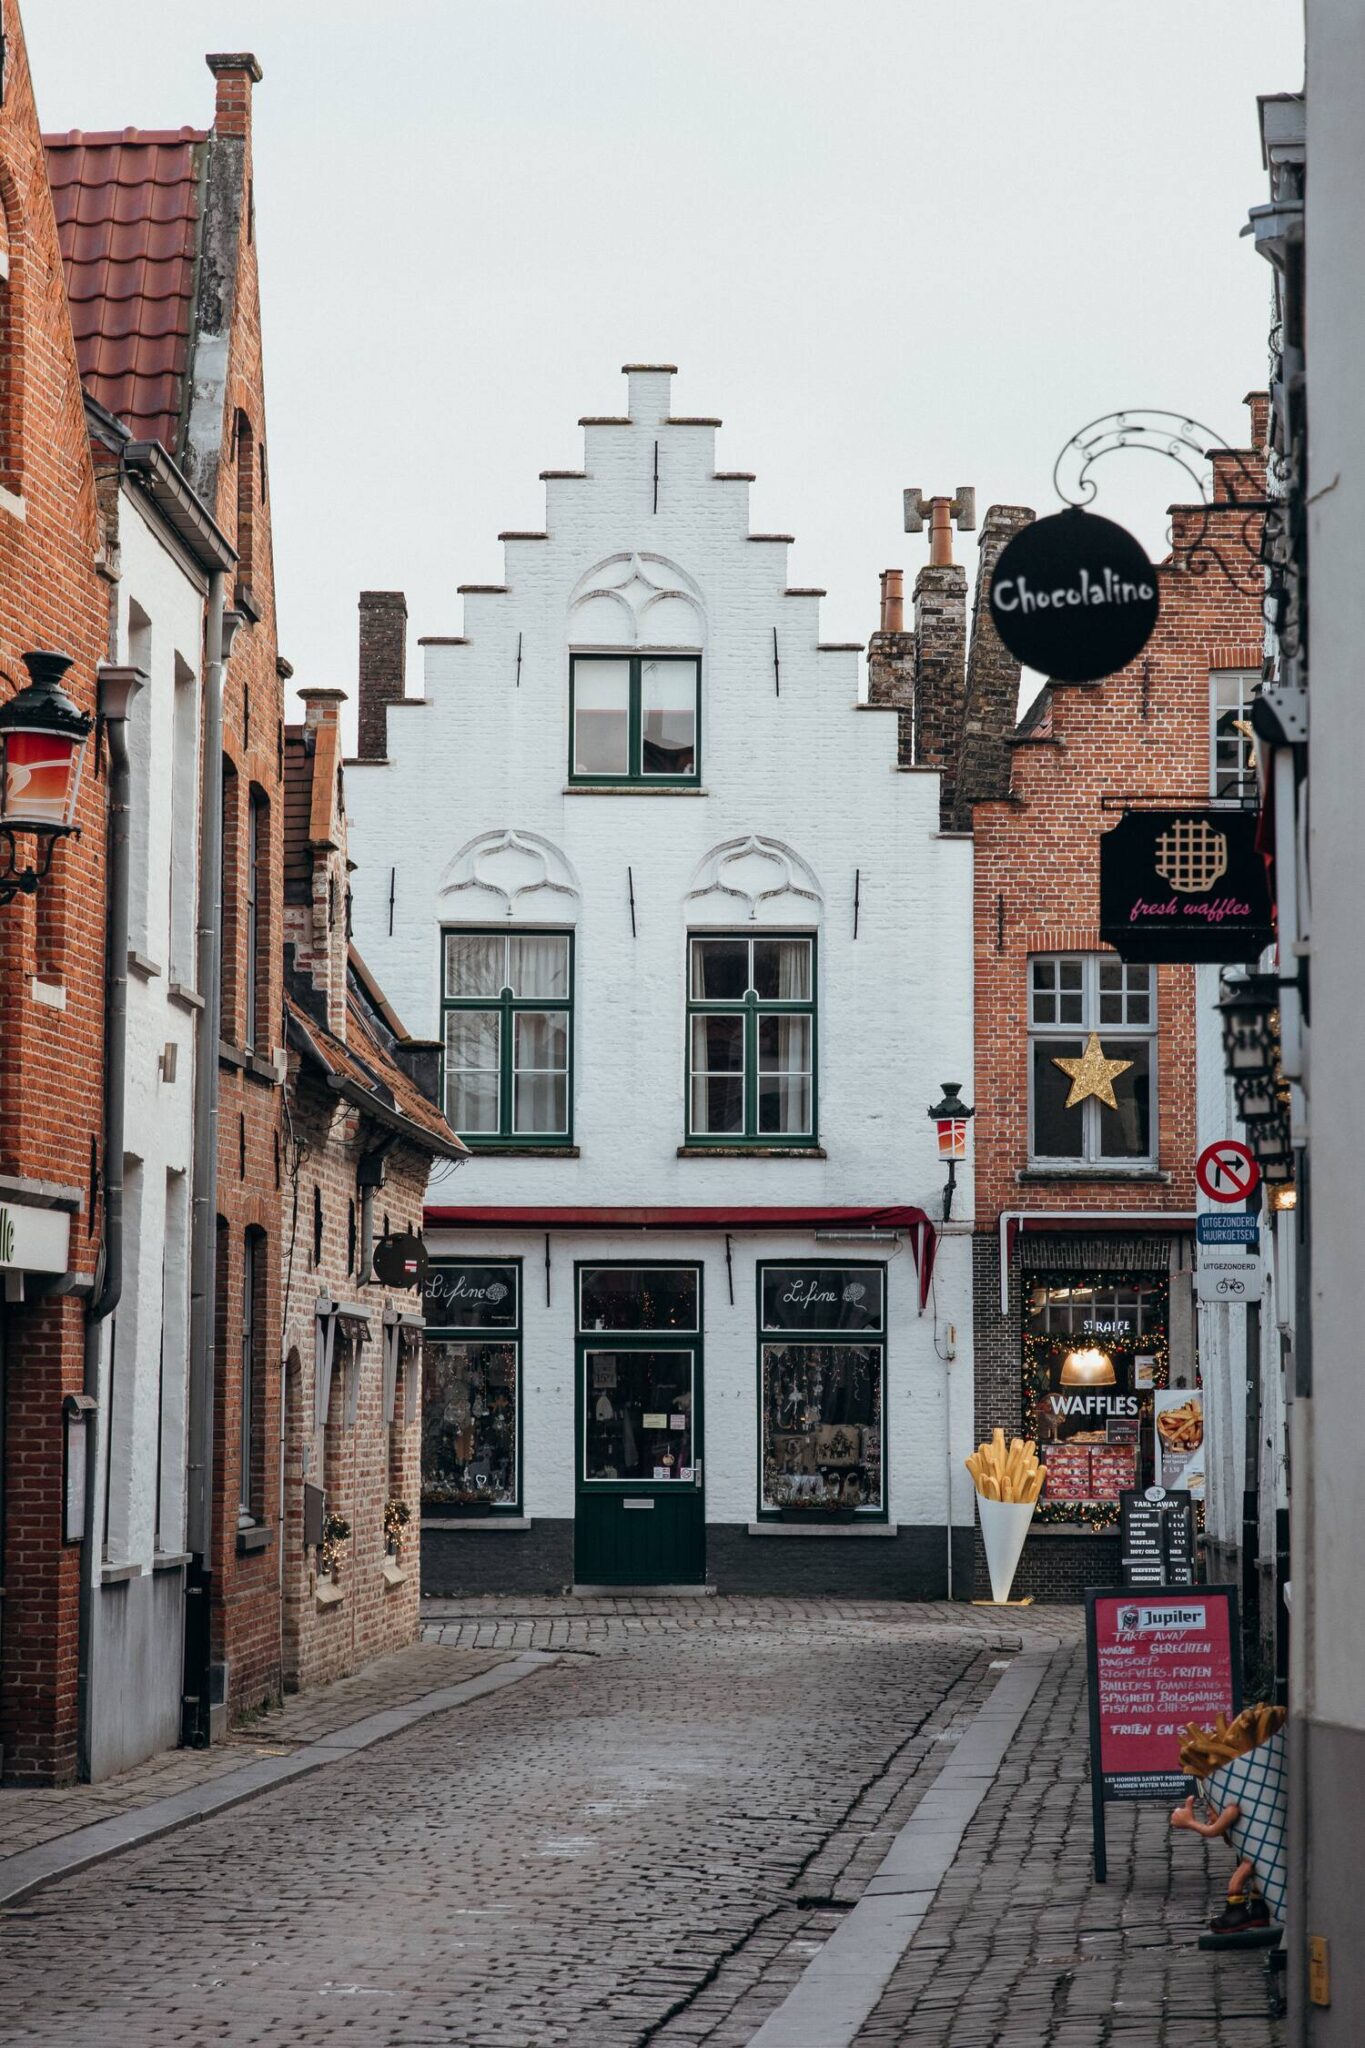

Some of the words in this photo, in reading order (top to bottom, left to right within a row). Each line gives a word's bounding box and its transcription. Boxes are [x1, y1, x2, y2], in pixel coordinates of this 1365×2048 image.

[994, 568, 1154, 614] Chocolalino
[1129, 897, 1178, 922] fresh
[1183, 897, 1250, 922] waffles
[1201, 1217, 1255, 1227] UITGEZONDERD
[1203, 1229, 1255, 1240] HUURKOETSEN
[425, 1274, 486, 1308] Lifine
[783, 1280, 838, 1309] Lifine
[1050, 1396, 1138, 1416] WAFFLES
[1144, 1610, 1202, 1626] Jupiler
[1112, 1632, 1147, 1642] TAKE
[1153, 1630, 1188, 1641] AWAY
[1150, 1643, 1211, 1655] GERECHTEN
[1101, 1704, 1129, 1714] FISH
[1130, 1704, 1155, 1713] AND
[1111, 1724, 1151, 1735] FRITEN
[1156, 1725, 1174, 1736] EN
